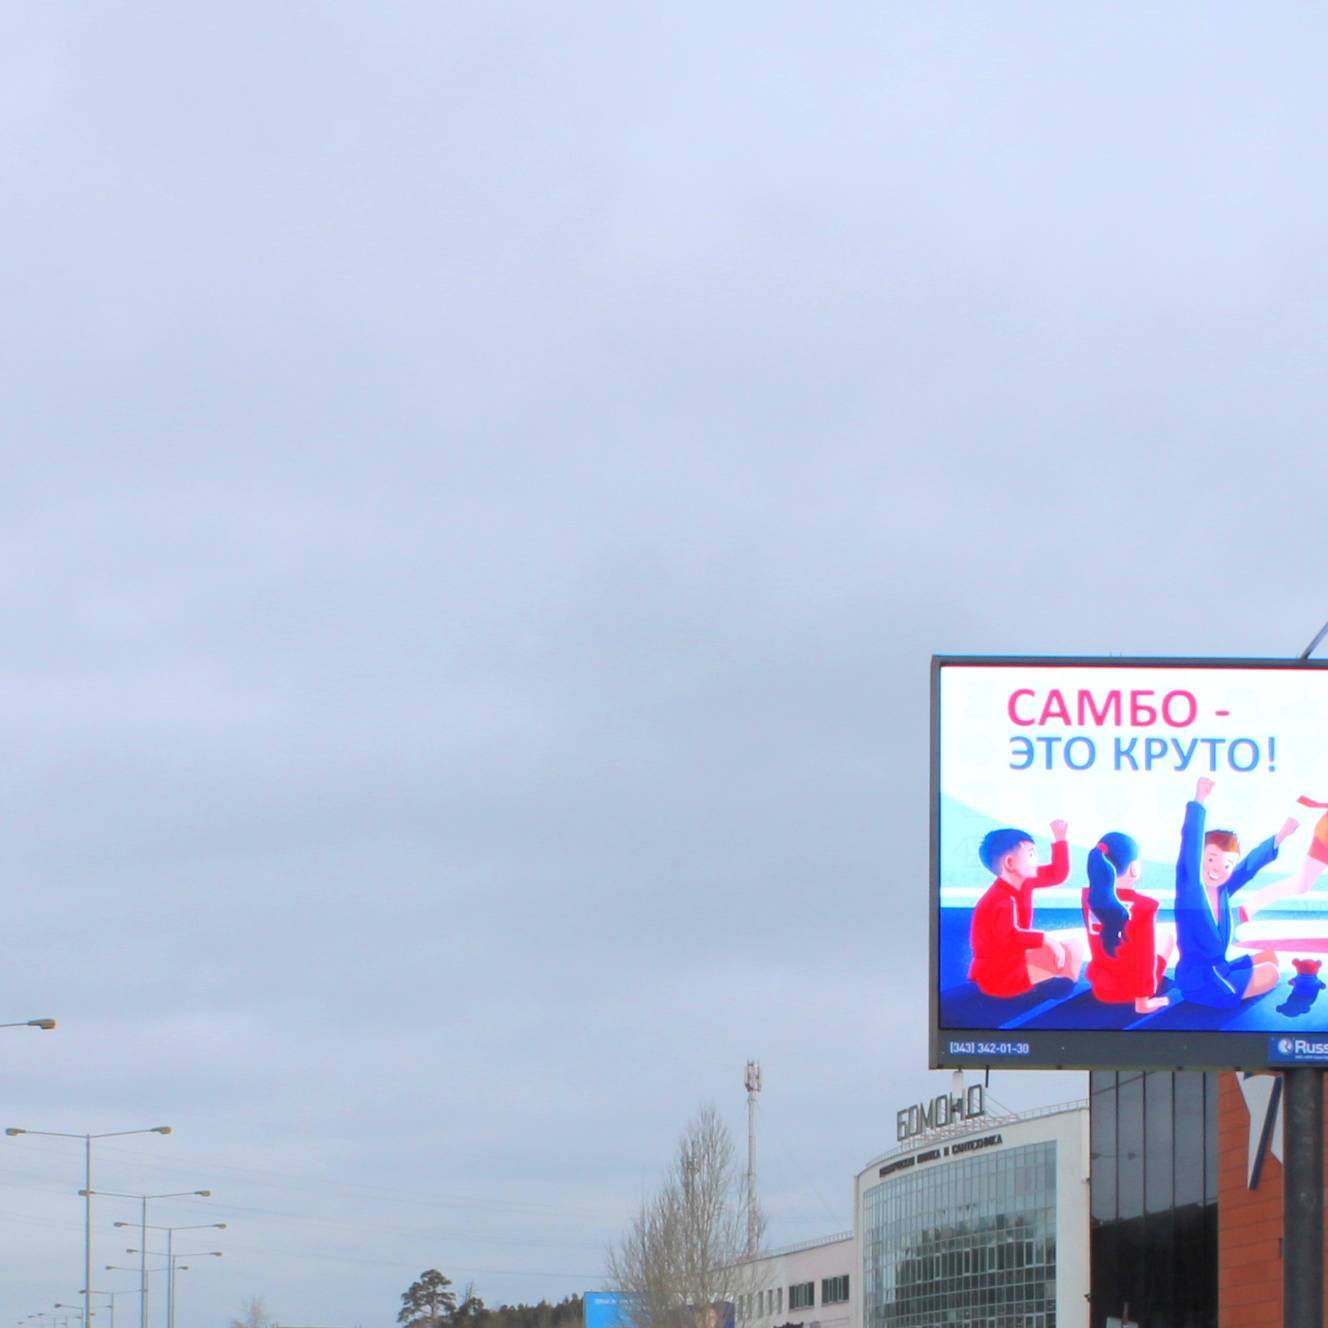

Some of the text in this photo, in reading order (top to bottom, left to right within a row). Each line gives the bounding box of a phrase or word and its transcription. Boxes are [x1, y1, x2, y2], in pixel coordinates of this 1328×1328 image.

[1007, 688, 1198, 728] САМБО
[1009, 735, 1276, 773] ЭТО КРУТО!
[949, 1041, 1030, 1054] (343) 342-01-30
[896, 1083, 986, 1142] БОМОНД
